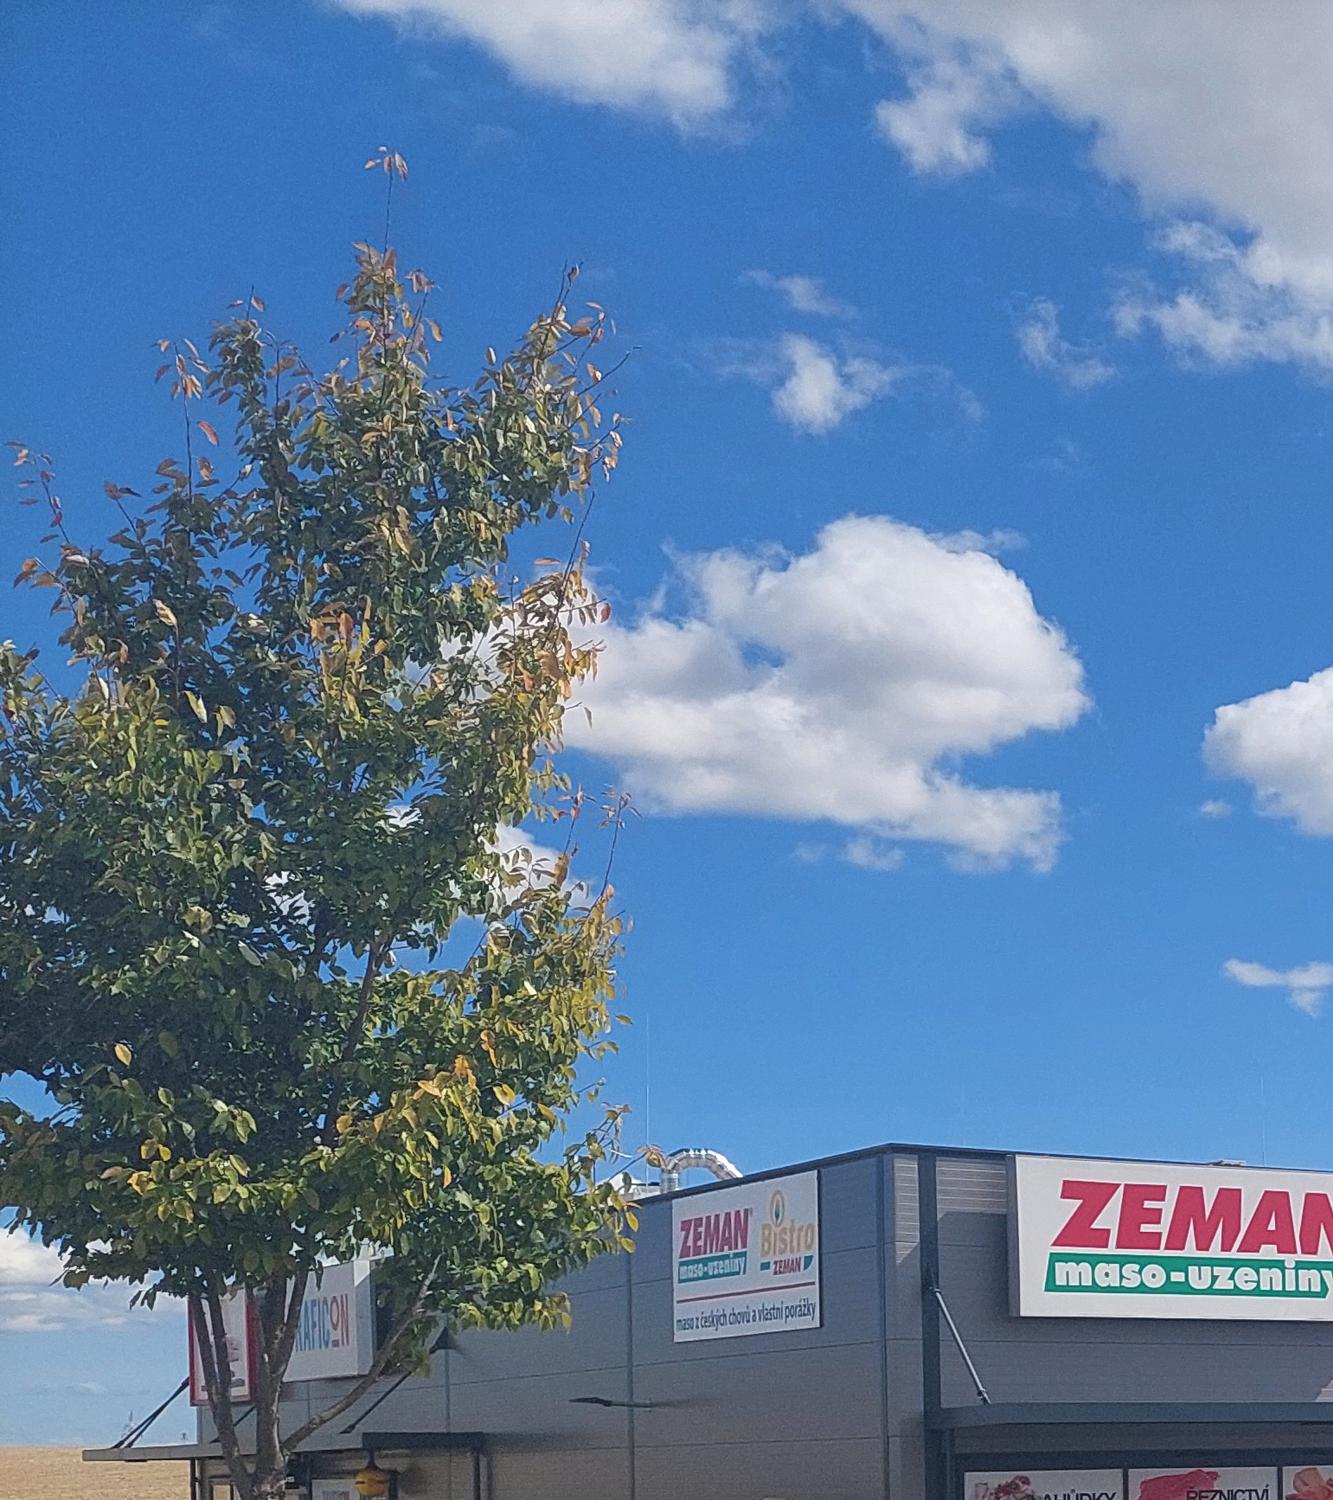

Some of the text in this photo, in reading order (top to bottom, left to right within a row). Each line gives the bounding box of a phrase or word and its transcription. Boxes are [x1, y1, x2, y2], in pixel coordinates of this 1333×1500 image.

[679, 1208, 750, 1259] ZEMAN
[760, 1219, 816, 1258] Bistro
[679, 1253, 746, 1280] maso-uzeniny
[772, 1256, 802, 1276] ZEMAN
[676, 1316, 694, 1331] maso
[700, 1308, 727, 1332] českých
[728, 1305, 751, 1324] chovů
[751, 1309, 757, 1321] a
[757, 1302, 784, 1322] vlastní
[784, 1297, 817, 1325] porážky
